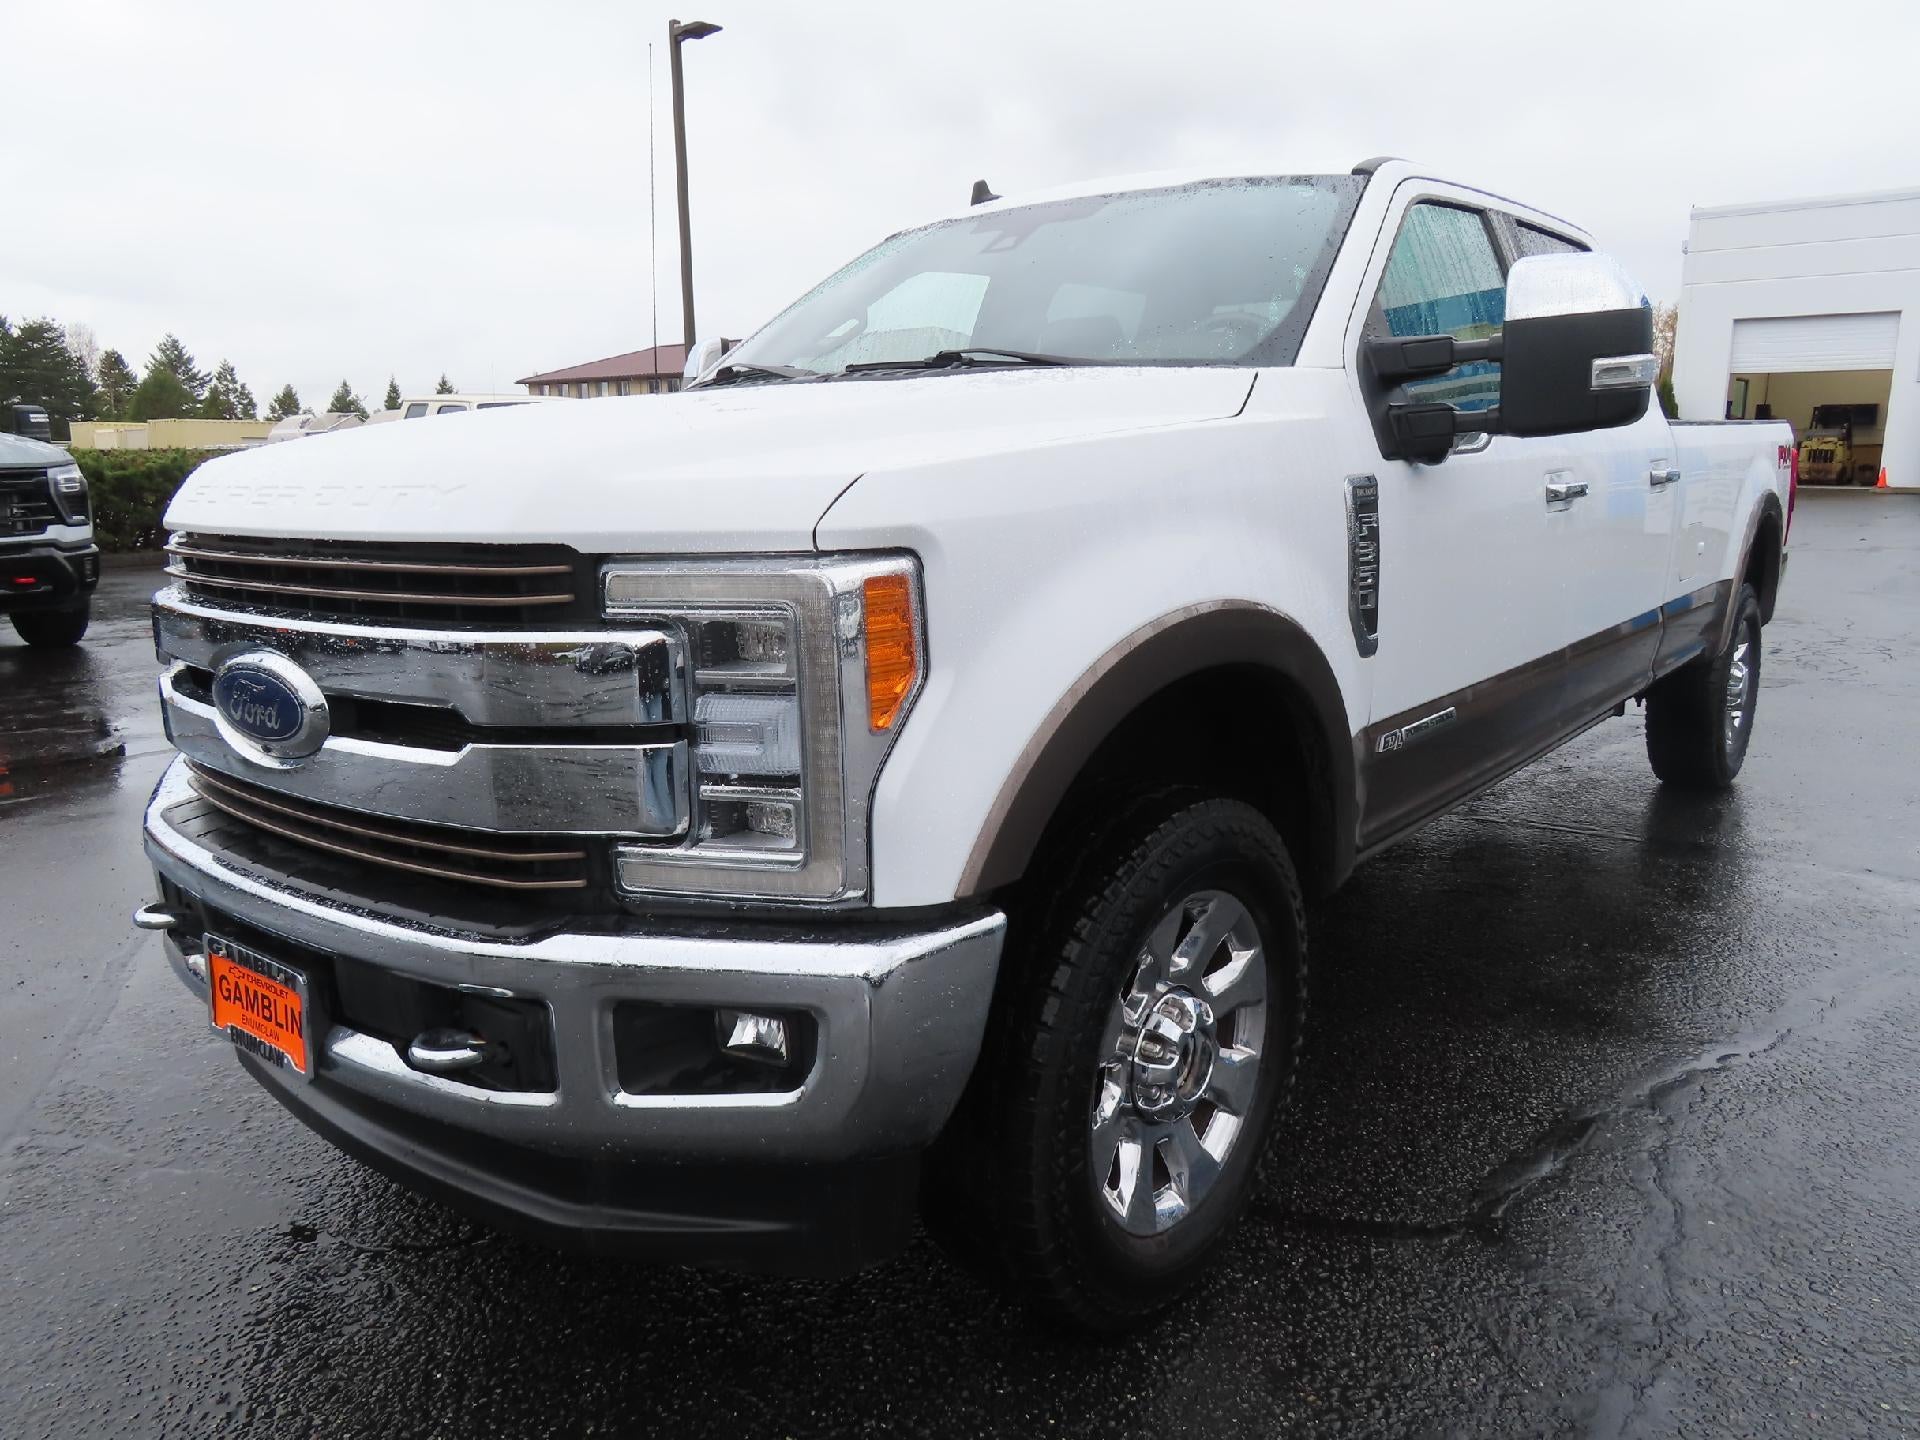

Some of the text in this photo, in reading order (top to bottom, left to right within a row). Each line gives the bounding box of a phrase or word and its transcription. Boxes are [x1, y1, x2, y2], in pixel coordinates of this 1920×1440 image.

[314, 484, 468, 507] DUTY
[230, 679, 280, 730] Ford
[245, 974, 289, 999] CHEVROLET
[218, 974, 303, 1039] GAMBLIN
[241, 1013, 280, 1042] ENUMCLAW
[230, 1025, 285, 1068] ENUMCLAW
